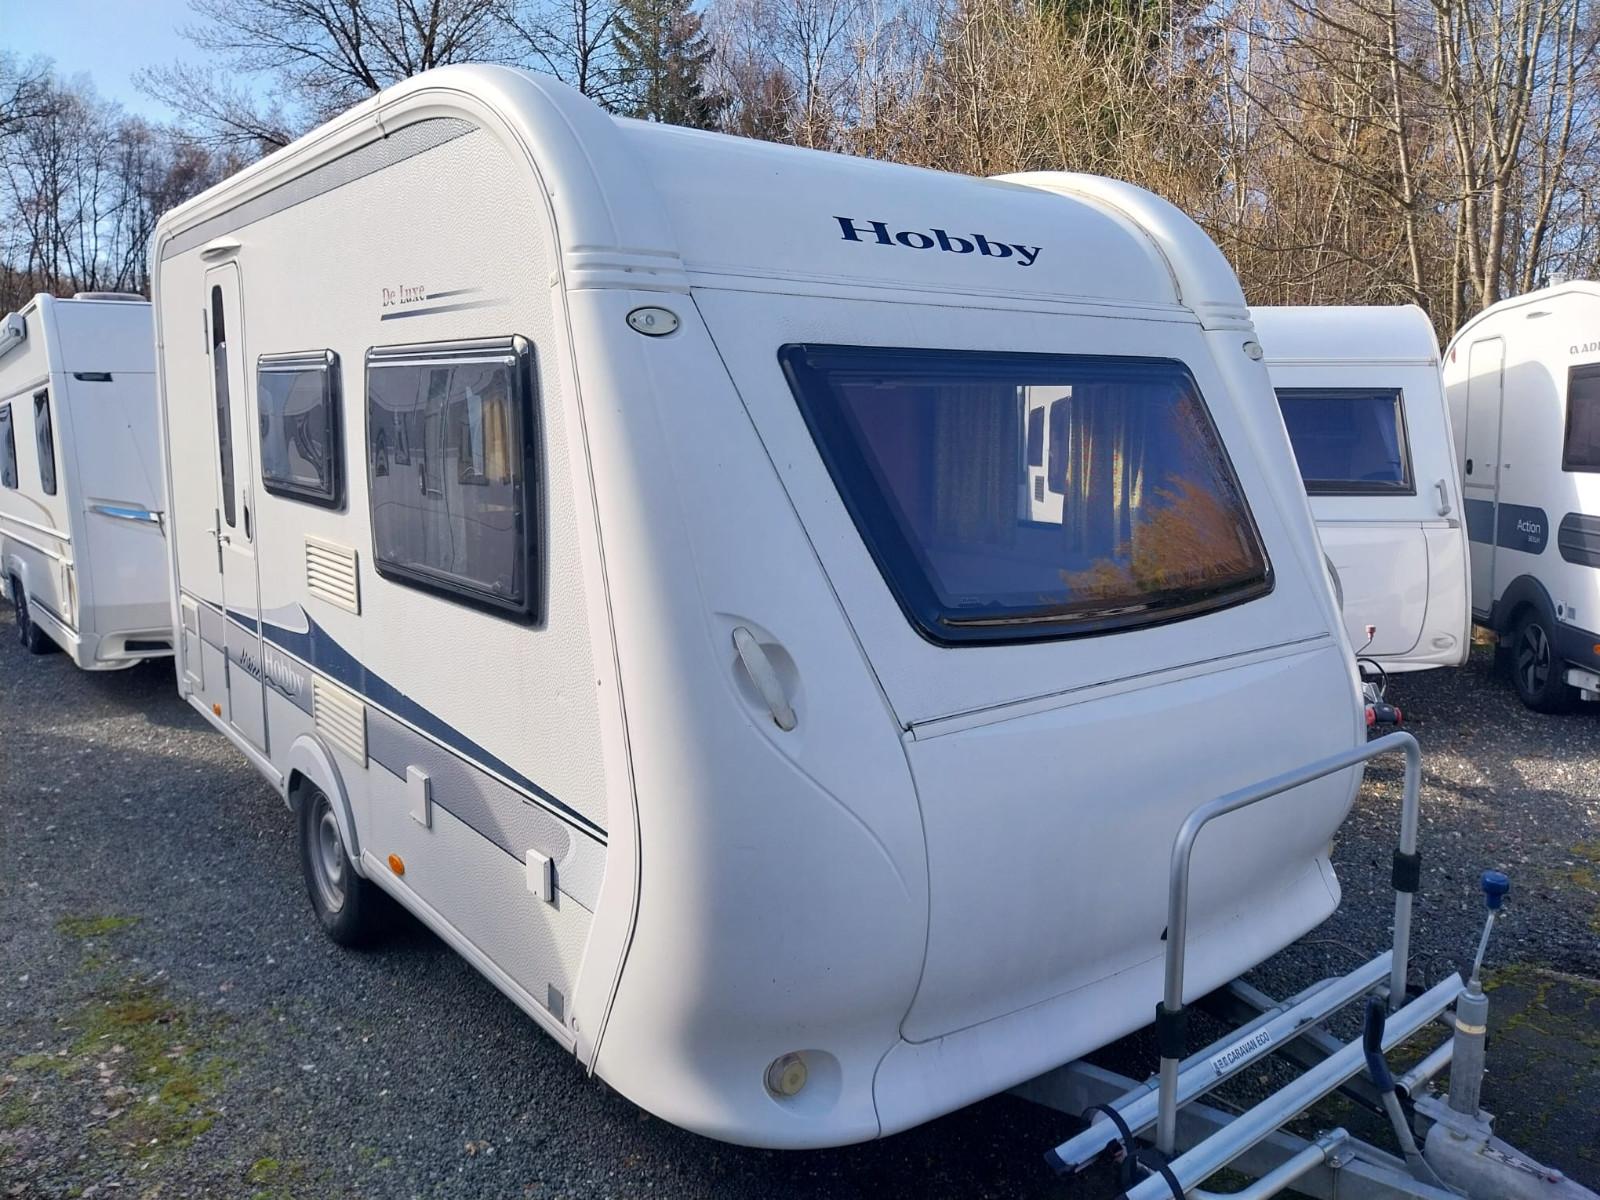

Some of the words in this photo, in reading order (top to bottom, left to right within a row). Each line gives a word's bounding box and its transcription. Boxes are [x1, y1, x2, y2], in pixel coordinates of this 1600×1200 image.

[832, 215, 1043, 267] Hobby
[382, 287, 396, 307] De
[399, 284, 425, 304] Luxe
[1516, 519, 1541, 534] Action
[1227, 1038, 1258, 1064] CARAVAN
[1255, 1031, 1270, 1046] ECO
